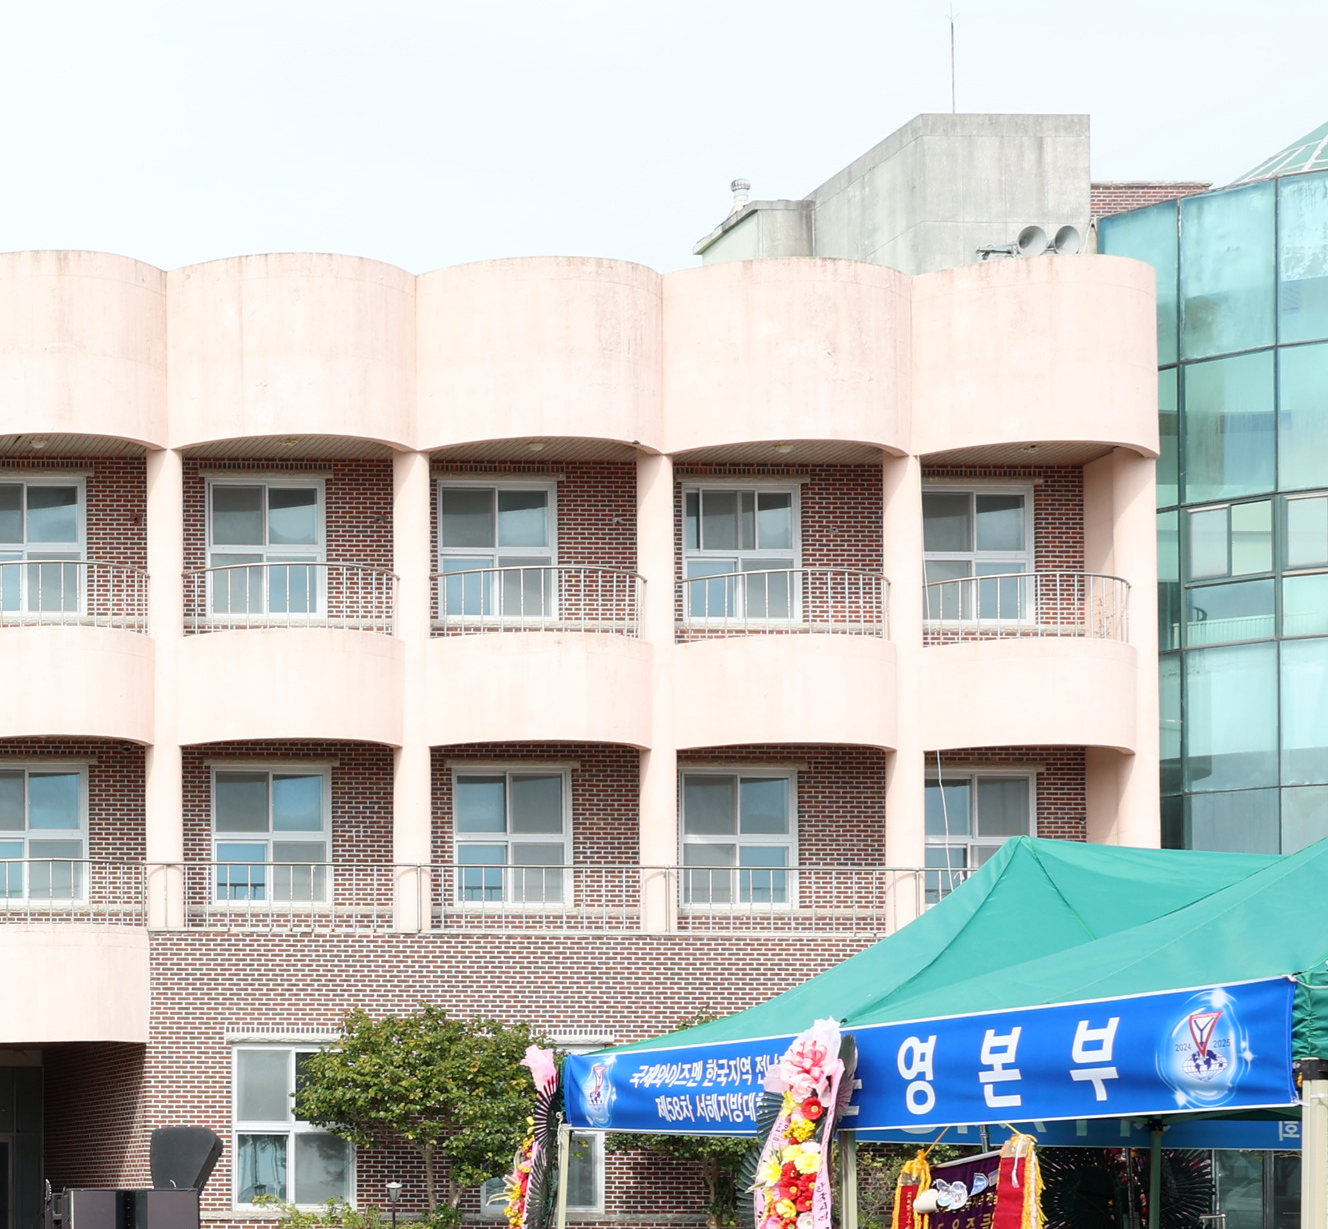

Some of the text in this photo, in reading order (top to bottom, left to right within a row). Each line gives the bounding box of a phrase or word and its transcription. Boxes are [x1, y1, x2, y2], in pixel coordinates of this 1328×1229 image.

[1175, 1038, 1231, 1052] 2024 2025
[630, 1060, 703, 1089] 국제와이즈멘
[705, 1056, 753, 1087] 한국지역
[655, 1093, 695, 1122] 제58차
